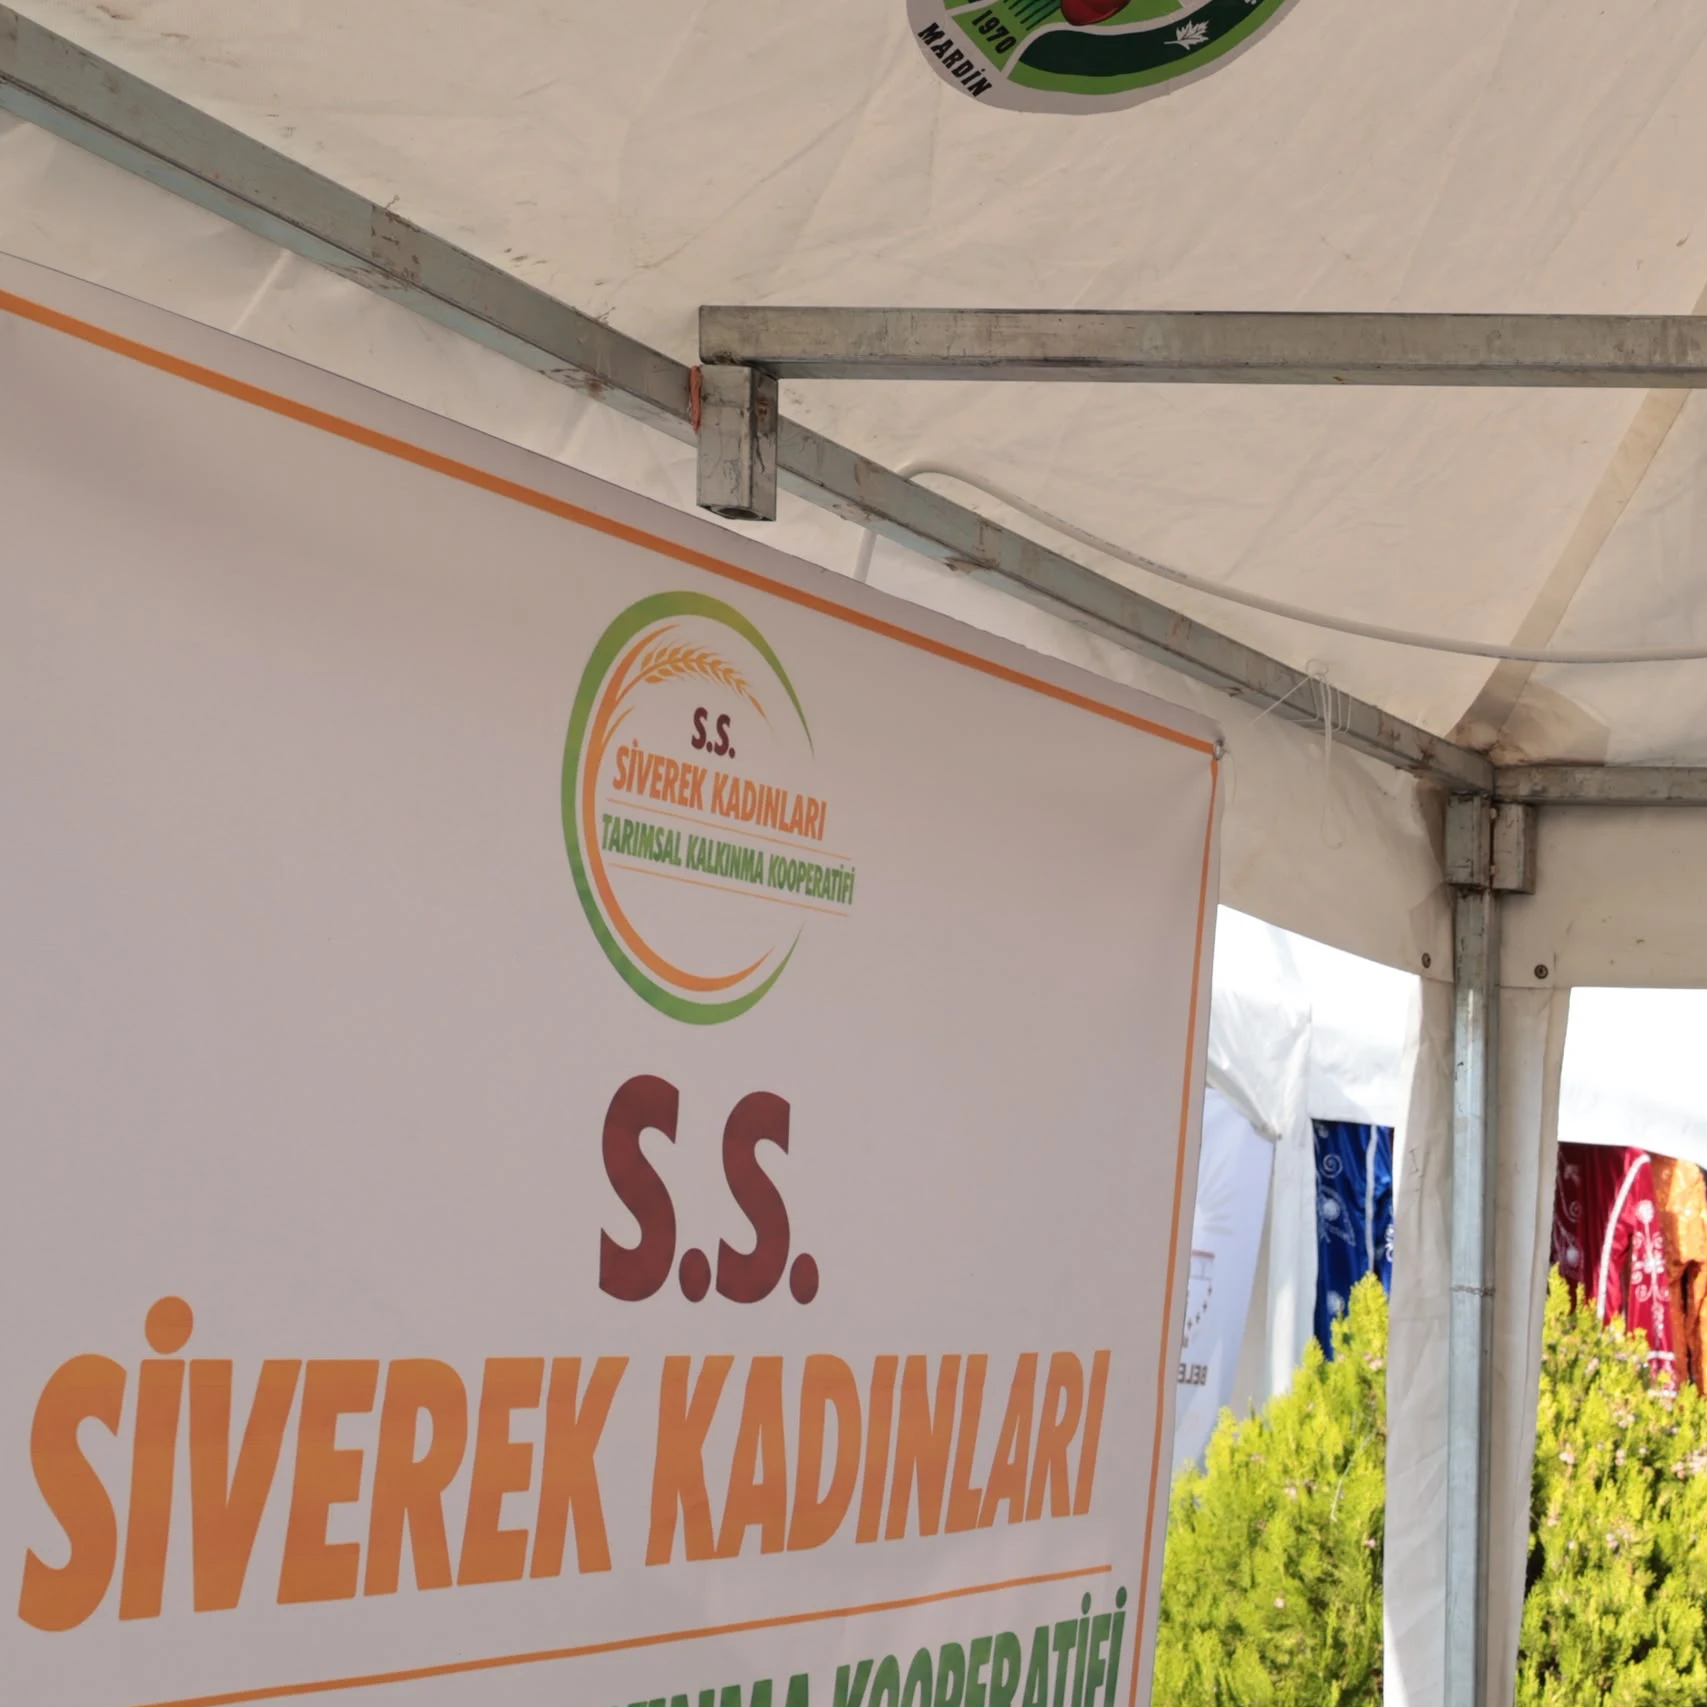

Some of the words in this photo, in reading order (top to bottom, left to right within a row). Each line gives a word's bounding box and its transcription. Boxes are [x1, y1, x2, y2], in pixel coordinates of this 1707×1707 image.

[917, 22, 993, 98] MARDİN
[971, 10, 1018, 55] 1970
[691, 706, 736, 759] S.S.
[612, 738, 707, 811] SİVEREK
[710, 771, 827, 841] KADINLARI
[602, 813, 682, 867] TARIMSAL
[686, 833, 764, 886] KALKINMA
[767, 854, 856, 906] KOOPERATİFİ
[600, 1074, 820, 1304] S.S.
[18, 1295, 629, 1632] SİVEREK
[645, 1349, 1111, 1567] KADINLARI
